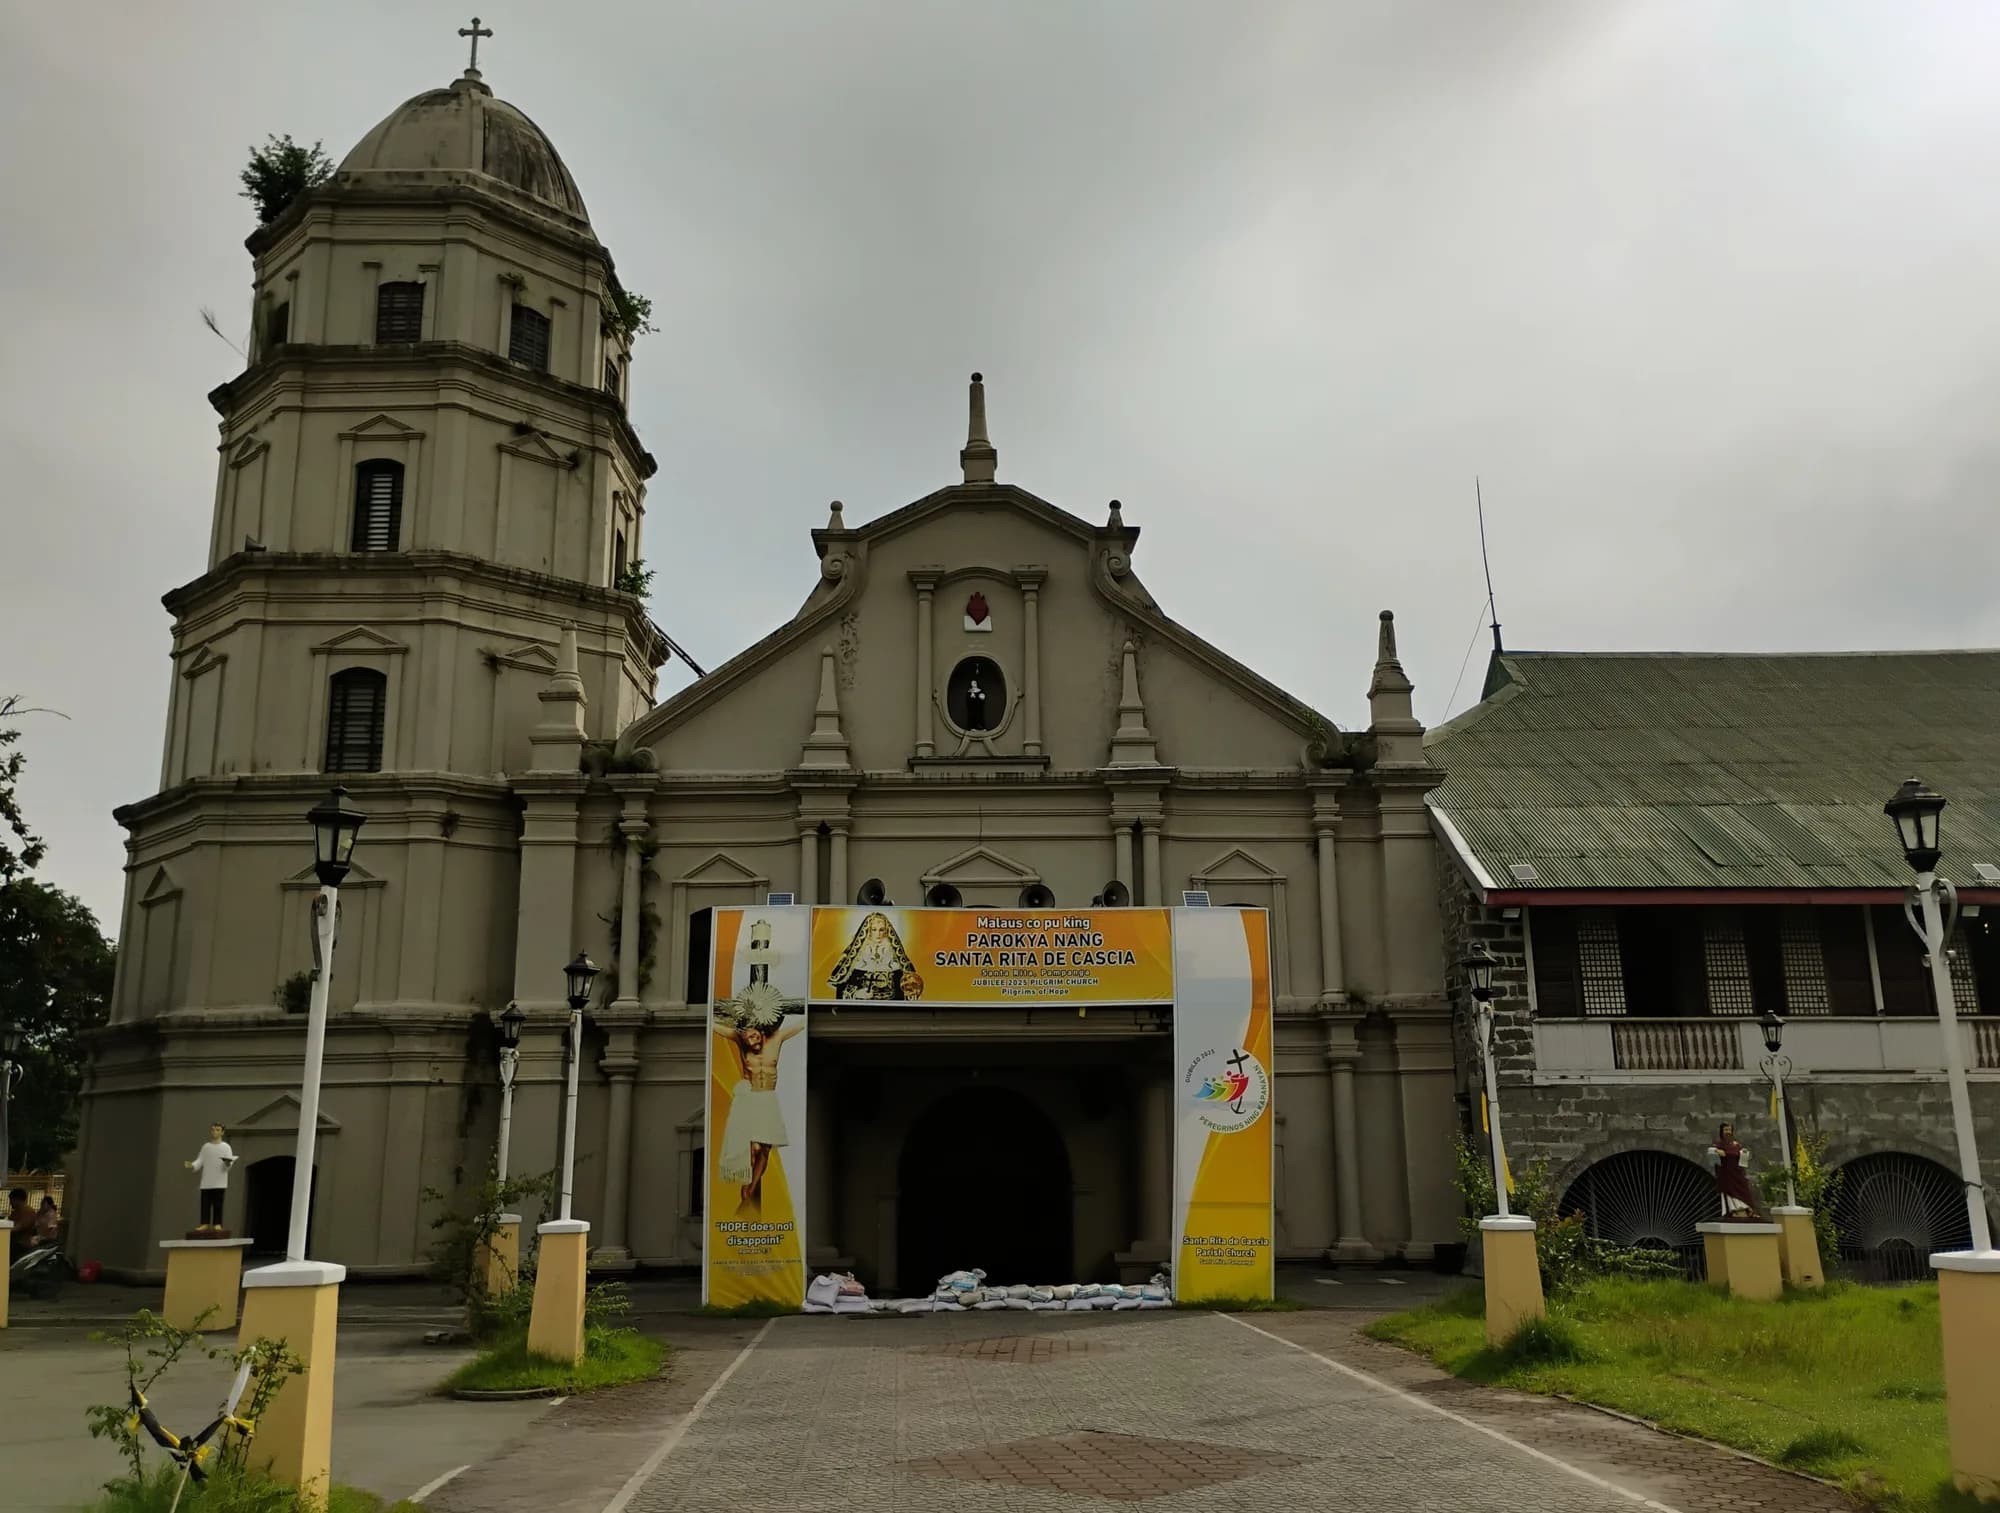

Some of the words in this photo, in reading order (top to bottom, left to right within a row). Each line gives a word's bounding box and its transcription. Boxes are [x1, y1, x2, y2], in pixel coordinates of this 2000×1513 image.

[977, 916, 1023, 929] Malaus
[1026, 918, 1040, 929] co
[1044, 918, 1060, 931] pu
[1063, 916, 1090, 930] king
[967, 933, 1048, 948] PAROKYA
[1054, 932, 1103, 947] NANG
[935, 951, 993, 966] SANTA
[999, 951, 1038, 966] RITA
[1044, 951, 1066, 966] DE
[1072, 950, 1136, 965] CASCIA
[1001, 988, 1035, 996] Pilgrims
[1049, 988, 1069, 996] Hope
[1199, 1115, 1244, 1132] PEREGRINOS
[1244, 1110, 1260, 1126] NING
[1254, 1064, 1267, 1110] KAPANAYAN
[750, 1221, 774, 1231] does
[777, 1221, 793, 1231] not
[1183, 1235, 1208, 1245] Santa
[1209, 1235, 1227, 1245] Rita
[1228, 1236, 1239, 1245] de
[1241, 1236, 1269, 1246] Cascia
[1195, 1247, 1224, 1257] Parish
[1225, 1248, 1256, 1257] Church
